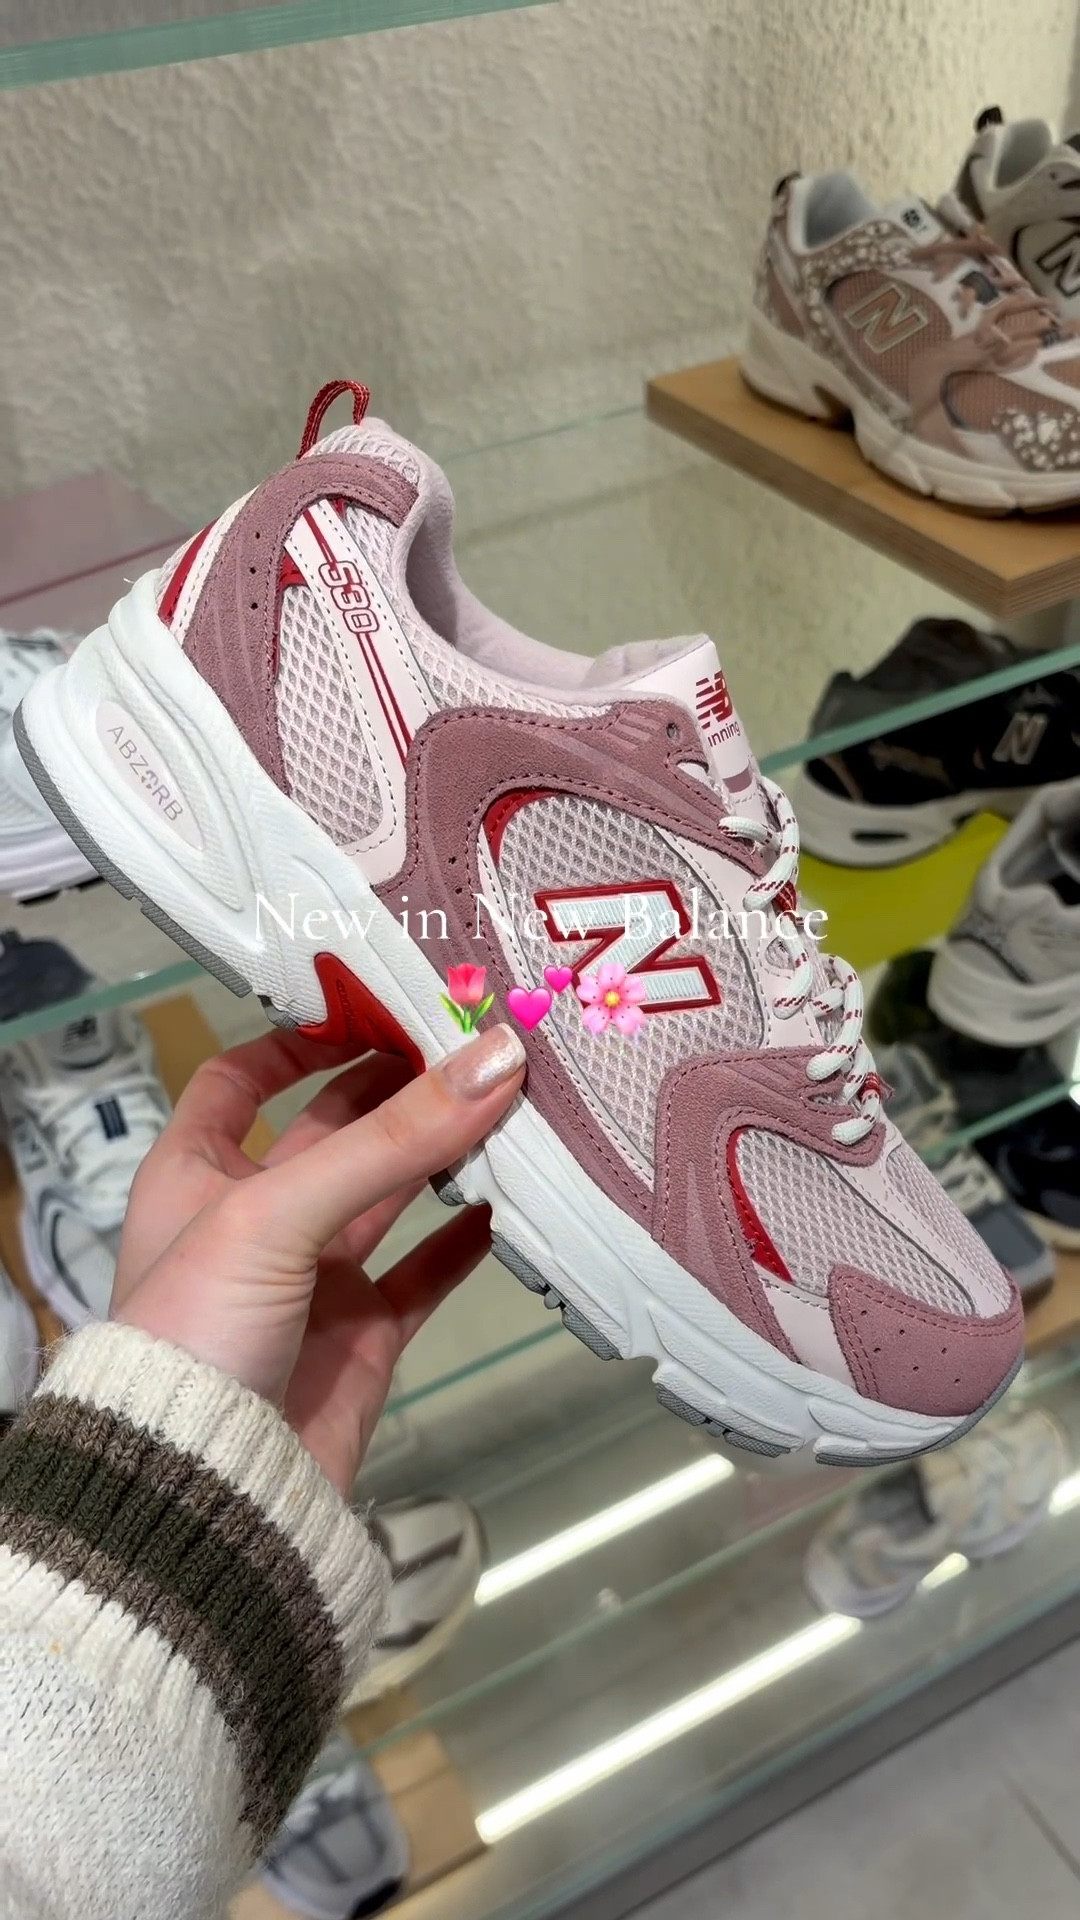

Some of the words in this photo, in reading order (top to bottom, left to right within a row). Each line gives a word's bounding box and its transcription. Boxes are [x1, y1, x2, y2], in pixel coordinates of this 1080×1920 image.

[846, 284, 929, 353] N
[318, 560, 380, 633] 530
[991, 711, 1048, 766] N
